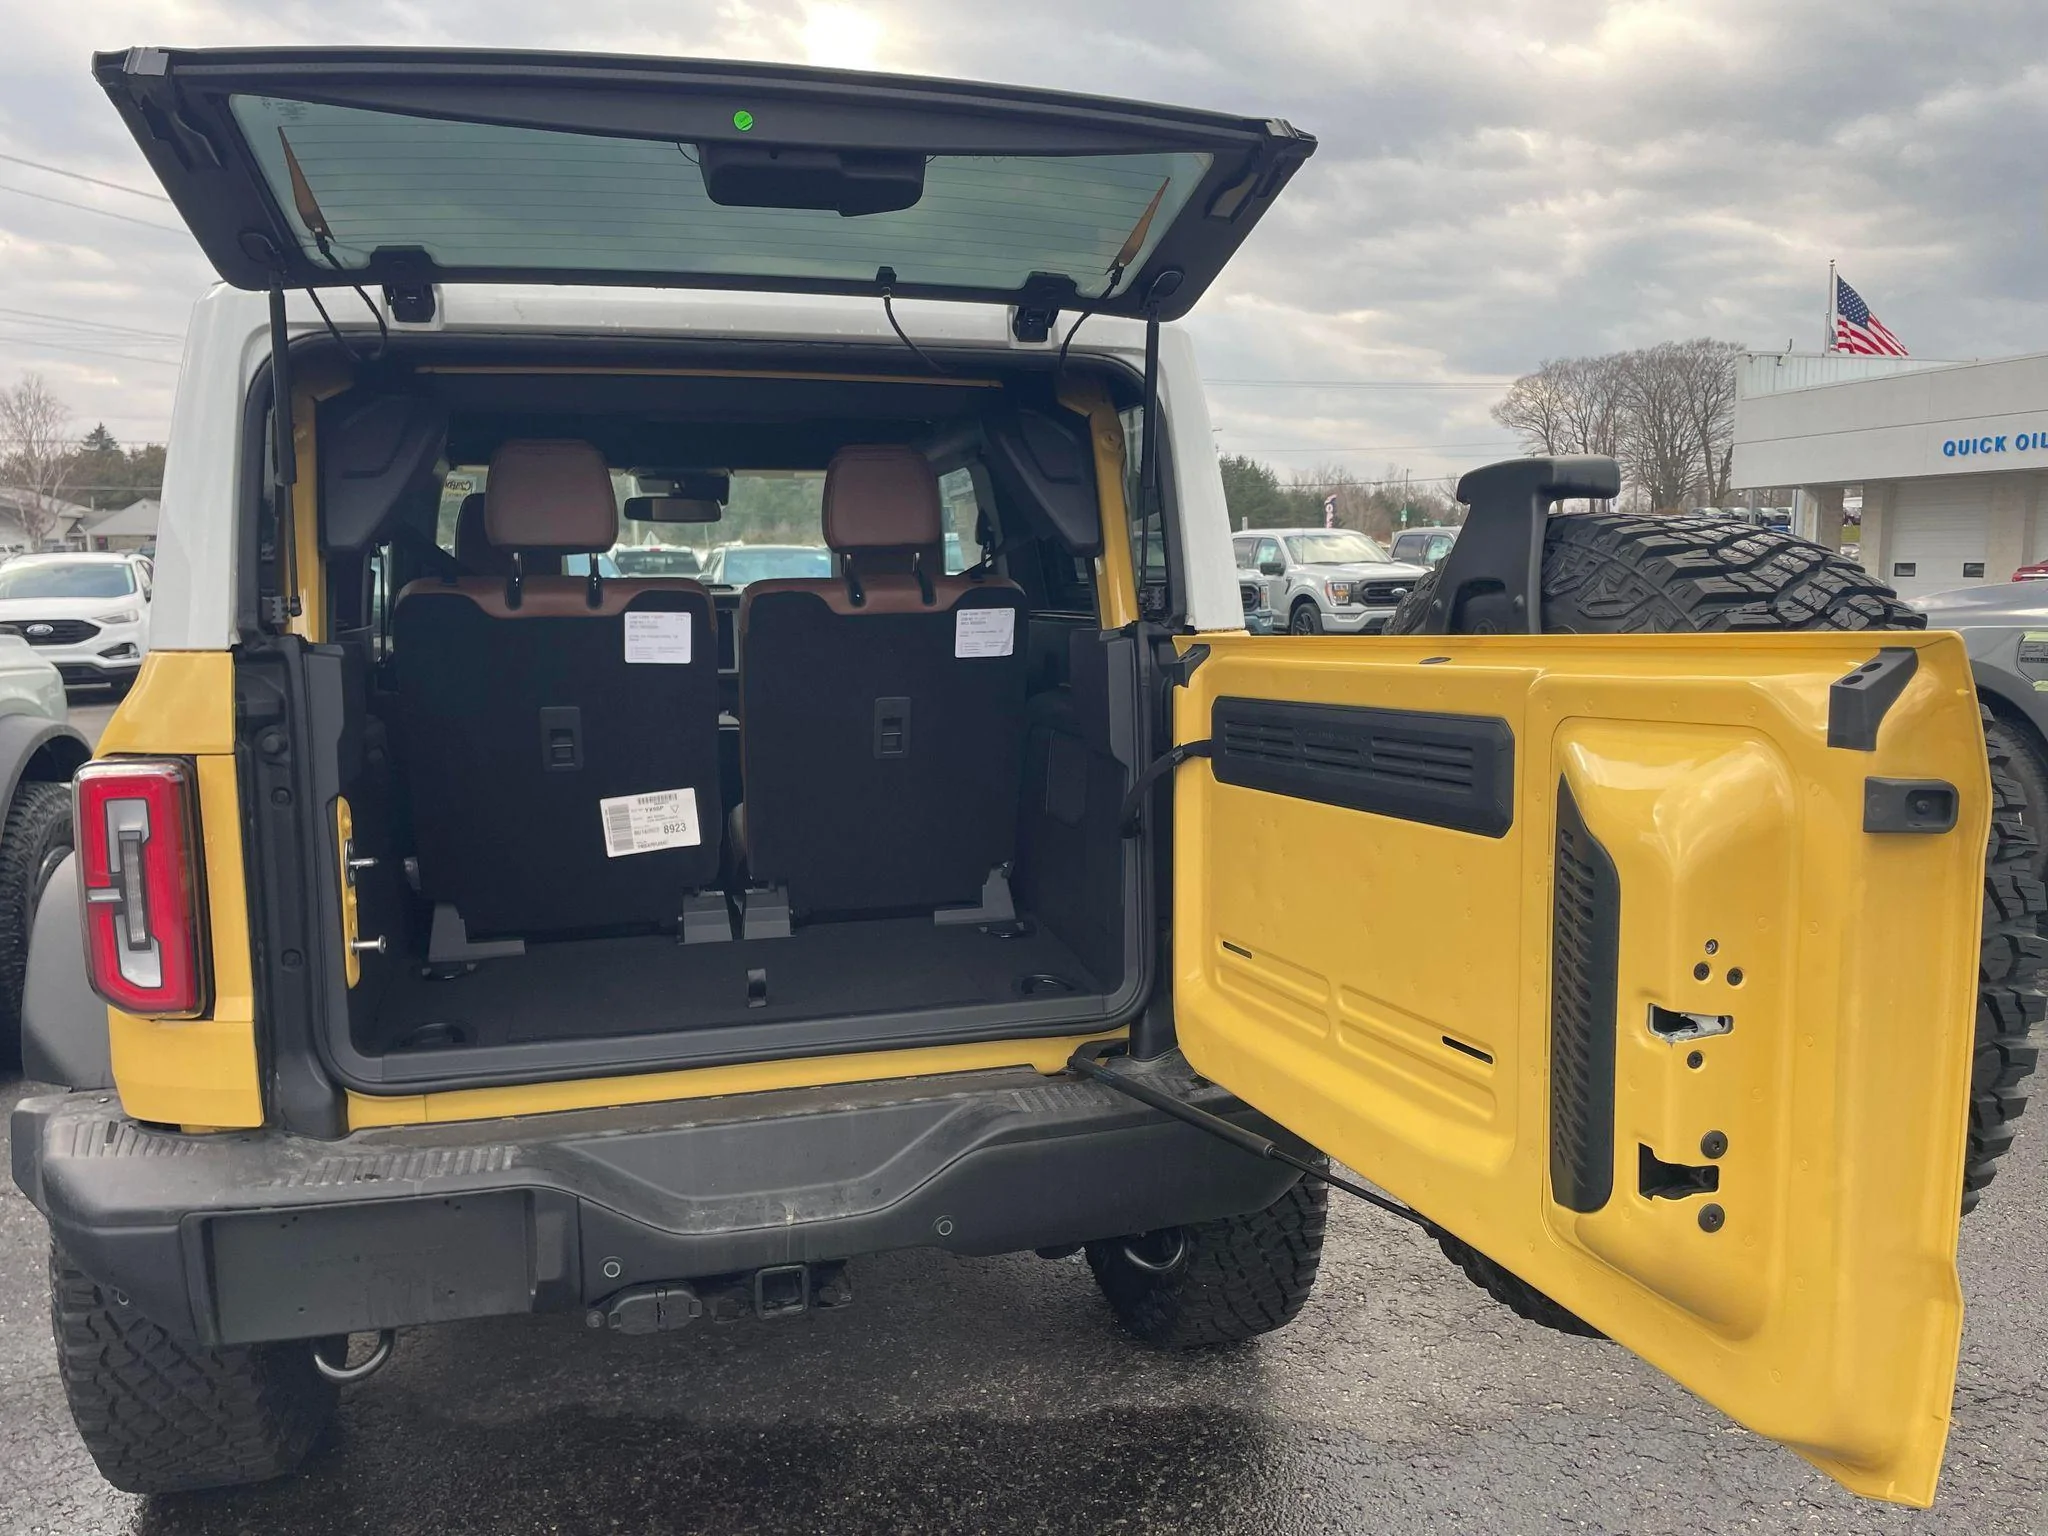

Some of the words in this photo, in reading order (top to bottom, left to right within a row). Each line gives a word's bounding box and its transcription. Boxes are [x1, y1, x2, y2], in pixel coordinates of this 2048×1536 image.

[1943, 435, 2007, 457] QUICK
[2015, 432, 2048, 451] OIL
[663, 822, 687, 834] 8923
